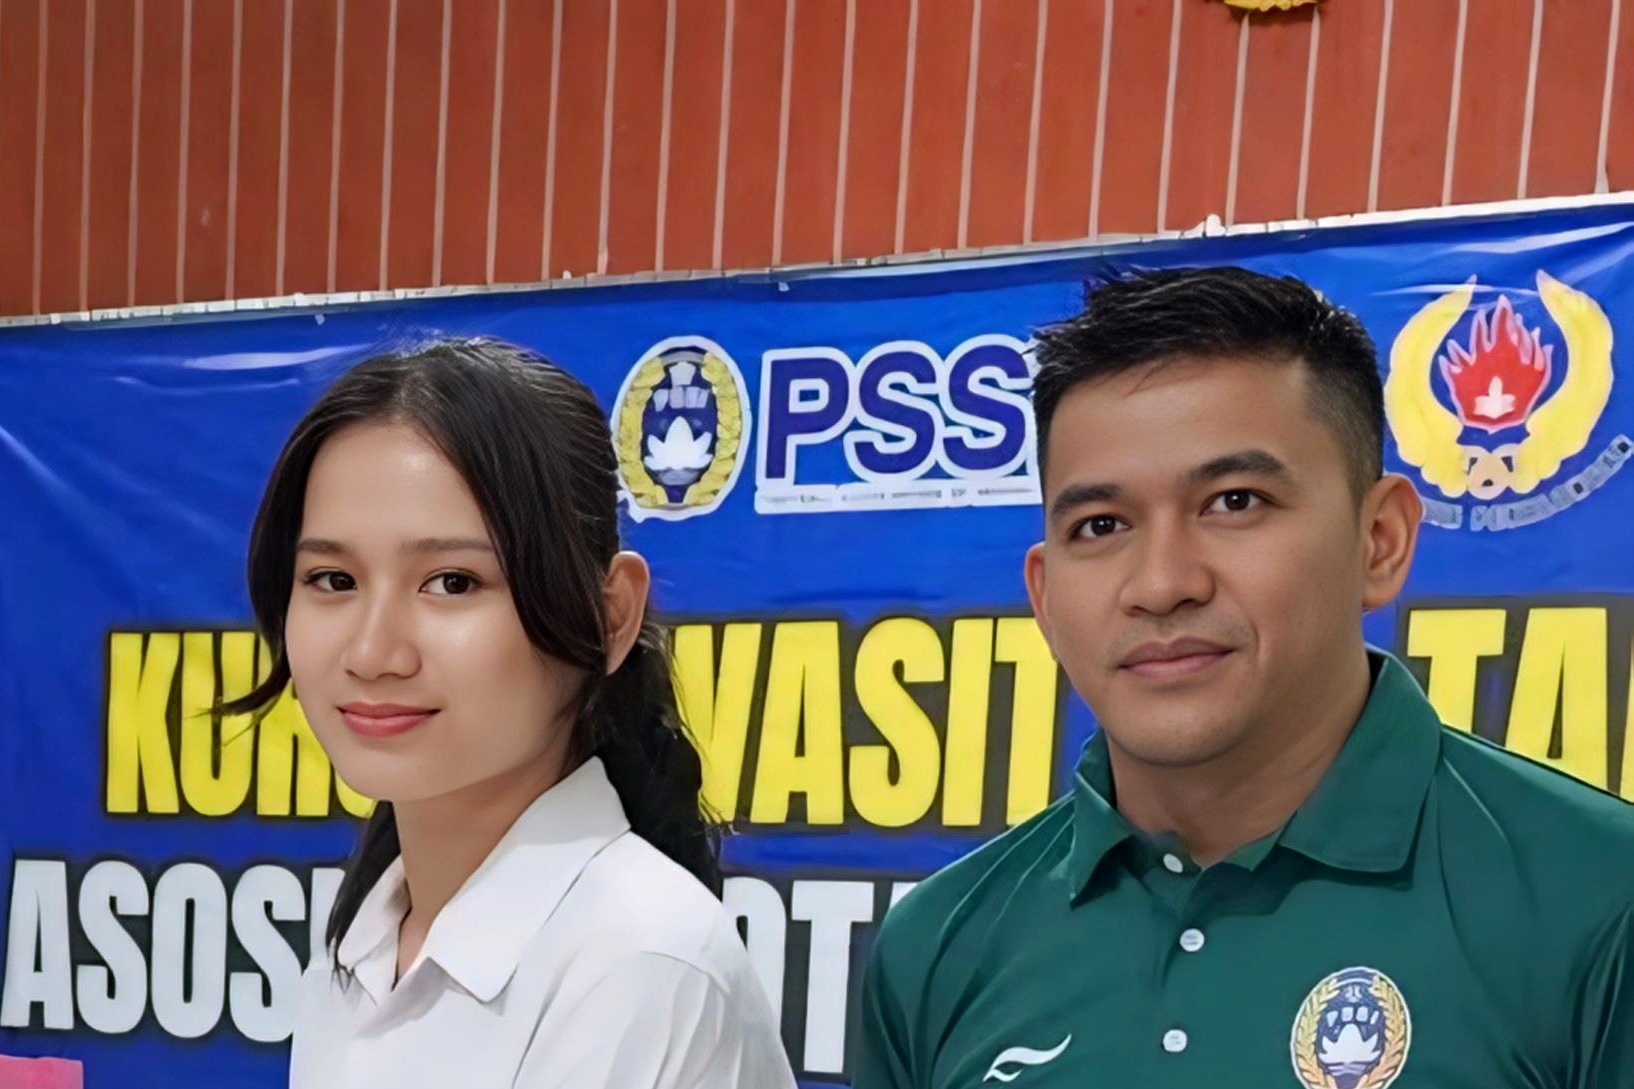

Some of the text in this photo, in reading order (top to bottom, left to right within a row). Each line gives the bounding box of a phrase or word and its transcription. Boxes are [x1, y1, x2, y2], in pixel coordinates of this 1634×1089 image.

[760, 334, 1042, 486] PSS
[106, 631, 374, 817] KUR
[1407, 607, 1634, 804] TA
